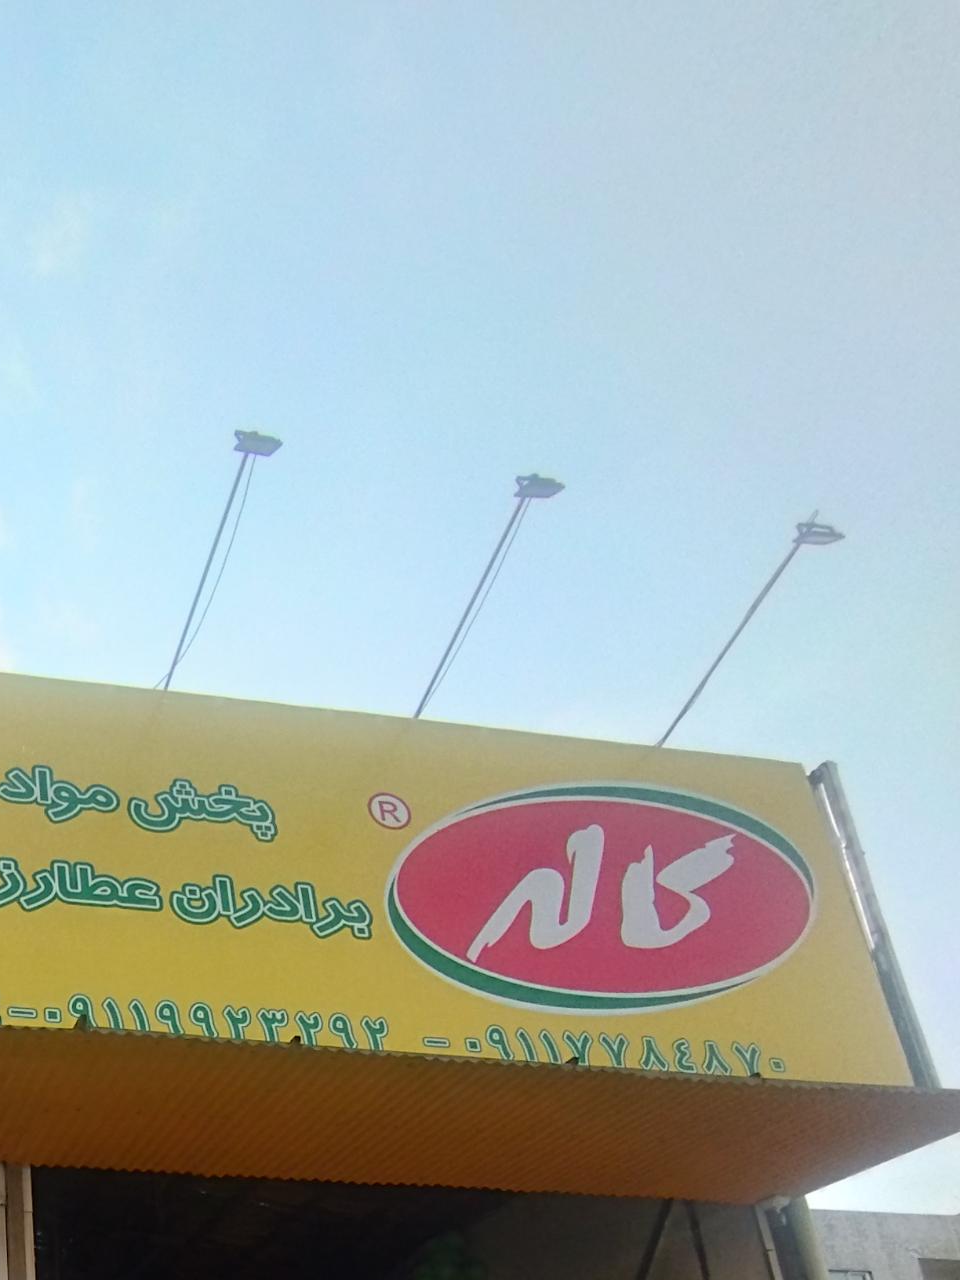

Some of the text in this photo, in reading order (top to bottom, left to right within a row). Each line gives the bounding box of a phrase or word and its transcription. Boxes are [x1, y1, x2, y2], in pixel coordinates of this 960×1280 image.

[129, 779, 278, 841] پخش
[170, 877, 372, 940] برادران
[466, 823, 737, 963] کاله
